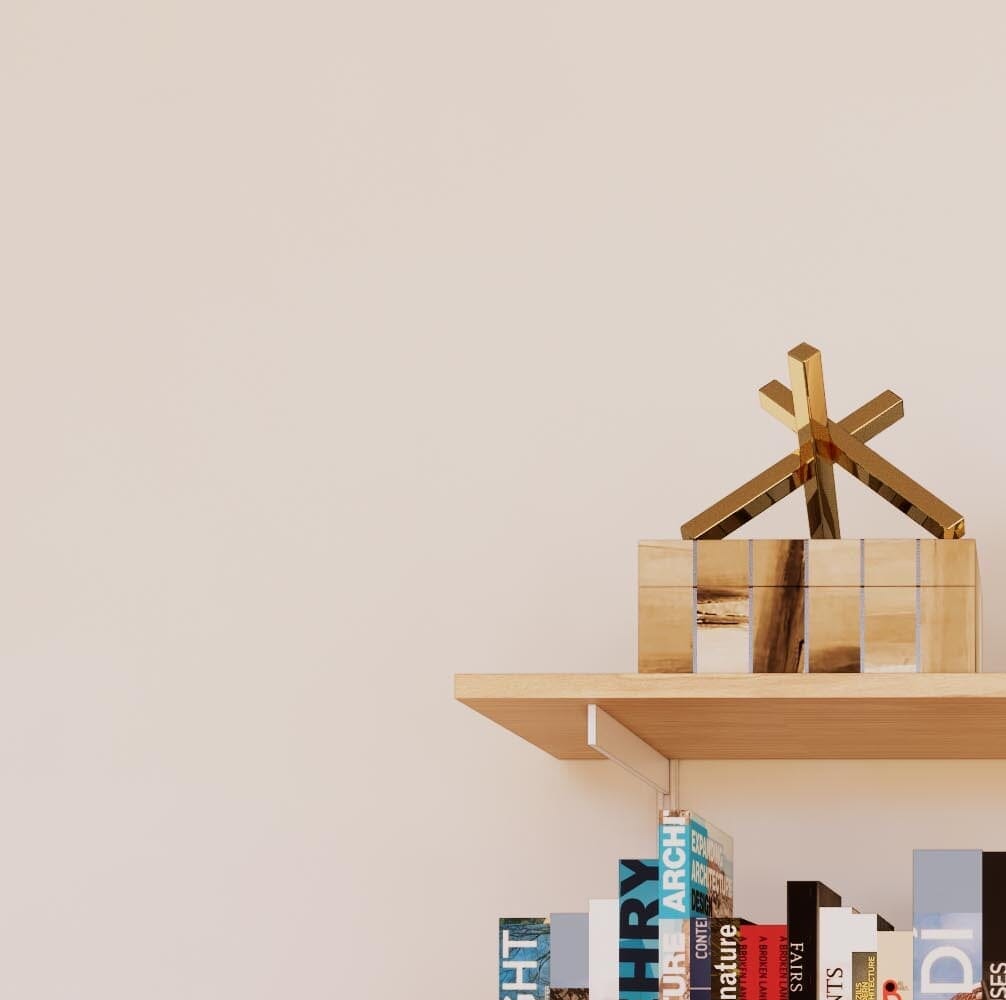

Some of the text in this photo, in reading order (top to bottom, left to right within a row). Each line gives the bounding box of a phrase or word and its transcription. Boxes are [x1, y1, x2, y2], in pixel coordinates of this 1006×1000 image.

[758, 944, 767, 979] BROKEN
[778, 944, 788, 979] BROKEN
[790, 942, 804, 992] FAIRS
